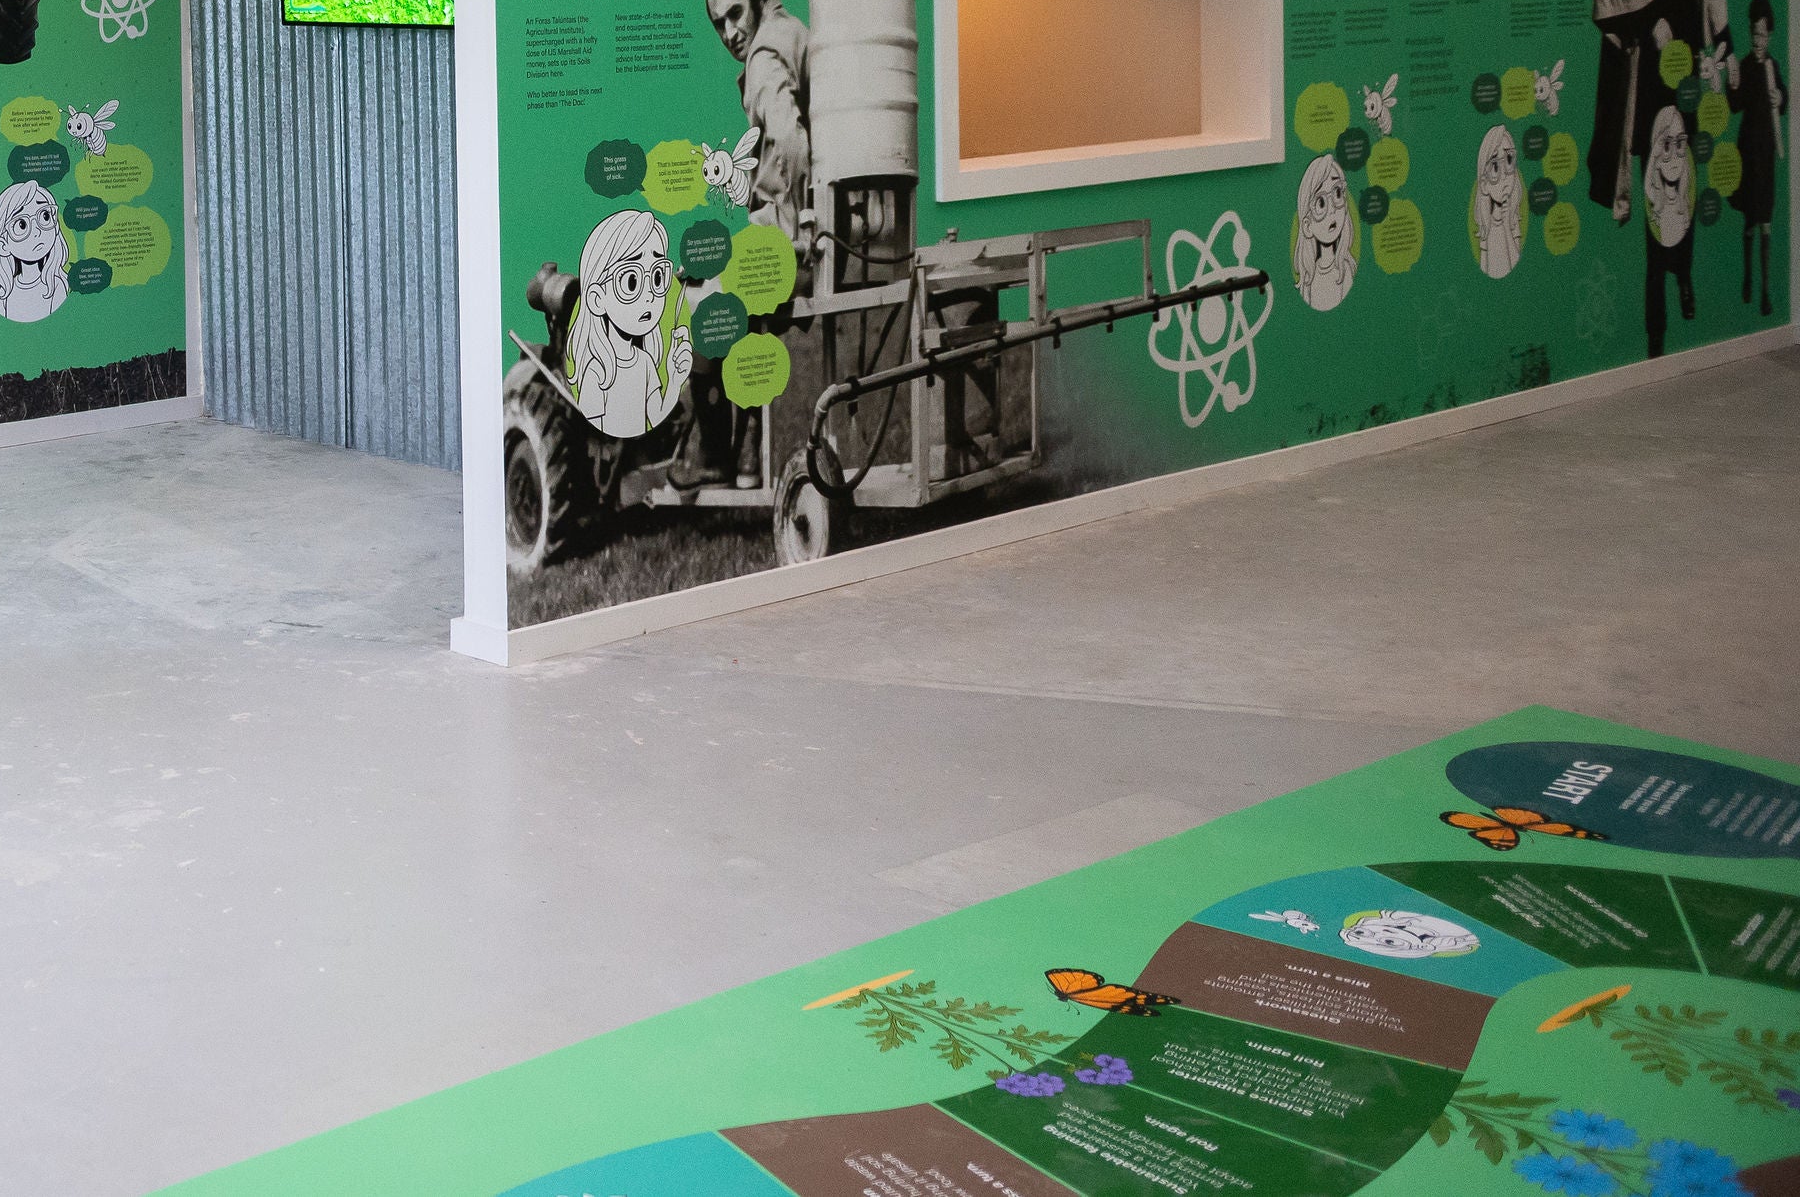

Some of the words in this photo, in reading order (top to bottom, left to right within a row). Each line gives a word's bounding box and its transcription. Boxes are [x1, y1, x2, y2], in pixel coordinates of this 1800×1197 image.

[1542, 761, 1614, 805] START
[1335, 976, 1370, 988] Miss
[1255, 999, 1340, 1024] Guesswork
[1294, 1054, 1325, 1068] Roll
[1167, 1068, 1246, 1096] supporter
[1250, 1092, 1314, 1117] Science
[1042, 1124, 1099, 1154] farming
[1186, 1134, 1219, 1152] Roll
[1100, 1152, 1188, 1195] Sustainable
